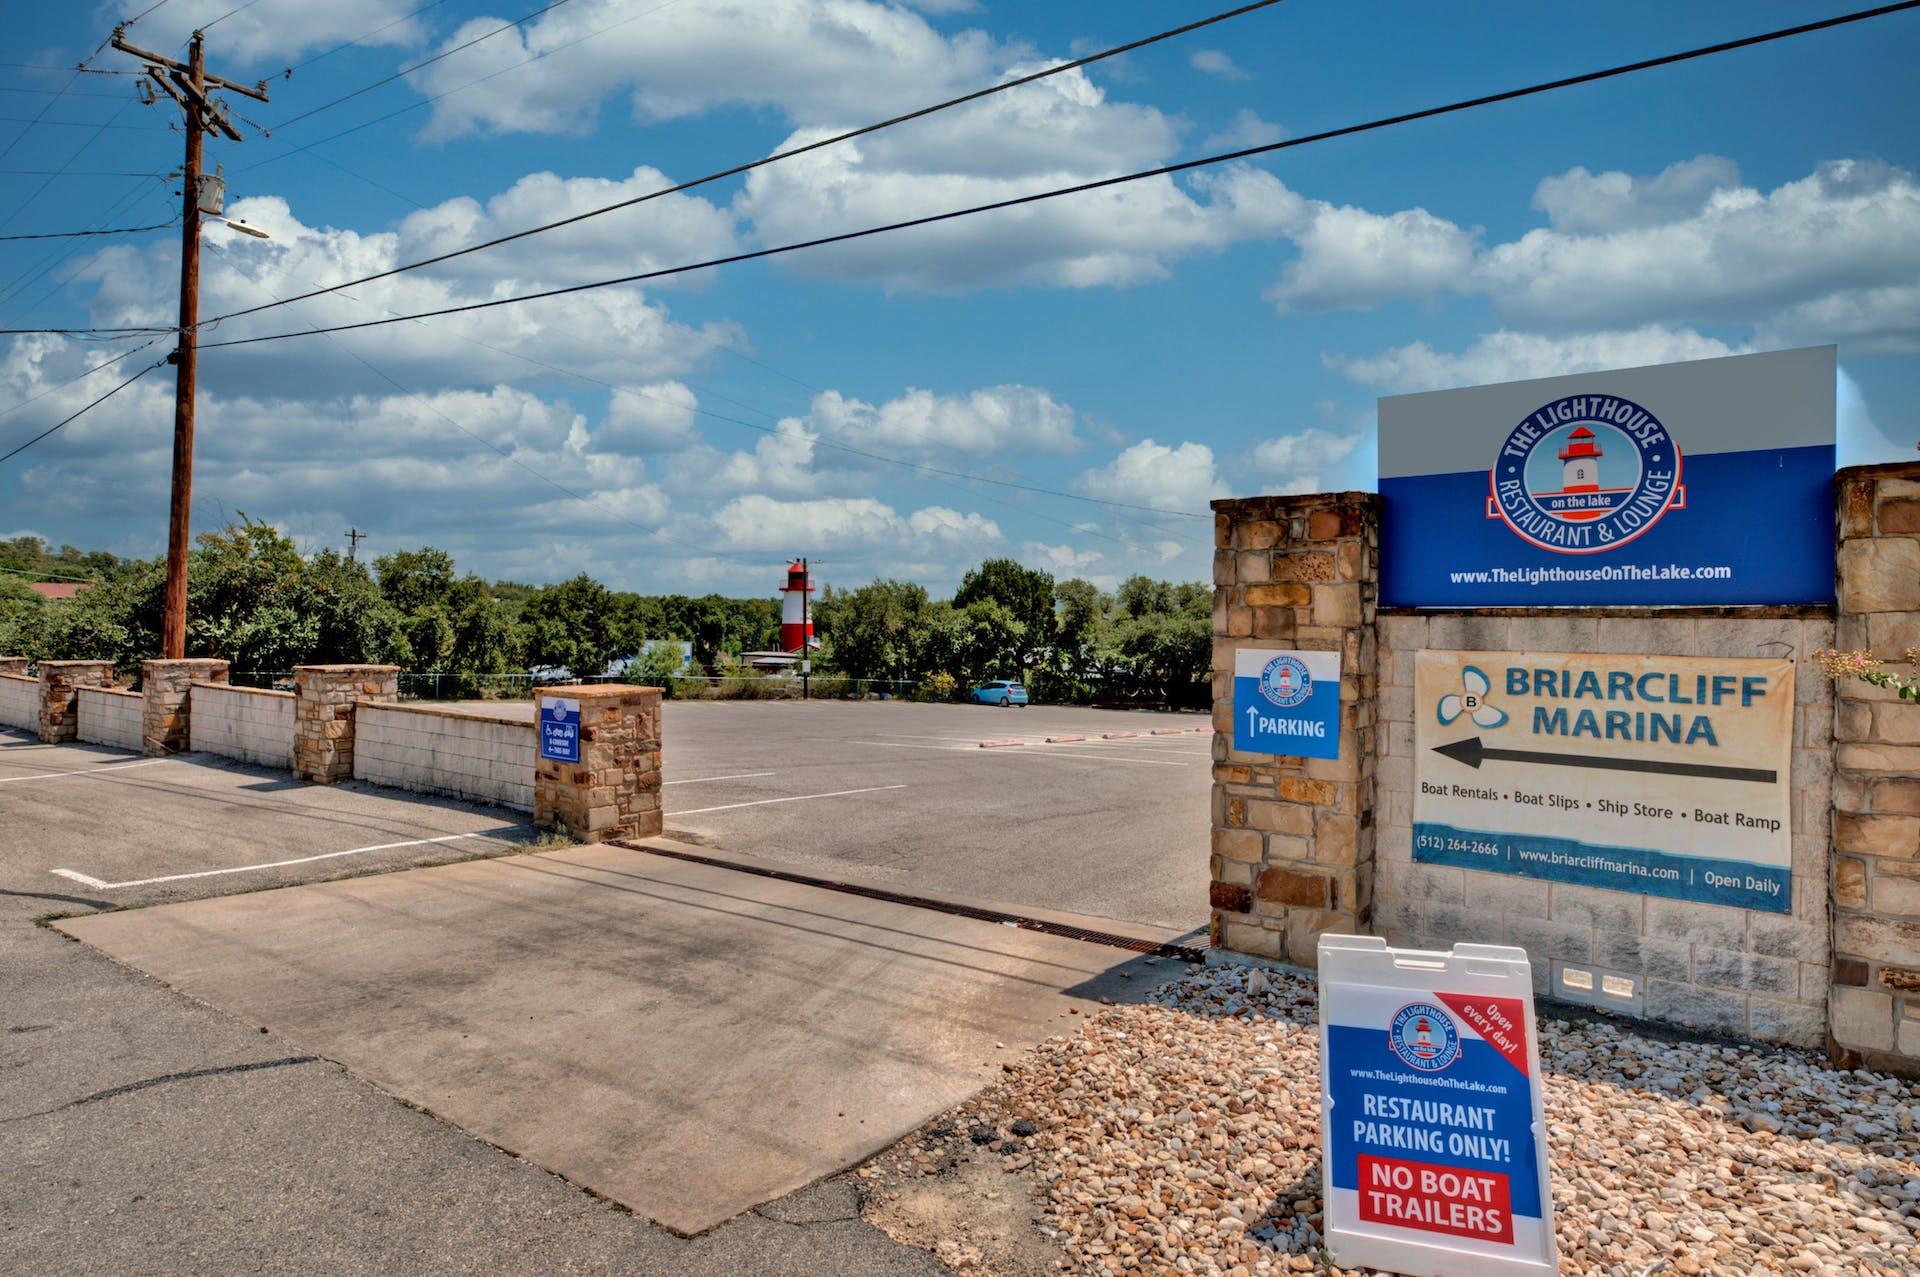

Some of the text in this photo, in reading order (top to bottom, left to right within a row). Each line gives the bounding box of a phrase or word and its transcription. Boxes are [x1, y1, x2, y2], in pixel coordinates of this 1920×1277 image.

[1504, 397, 1665, 457] THE LIGHTHOUSE
[1499, 469, 1671, 546] RESTAURANT & LOUNGE
[1551, 494, 1611, 508] on the lake
[1450, 564, 1731, 586] www.TheLighthouseOnTheLake.com
[1466, 696, 1476, 707] B
[1506, 667, 1767, 707] BRIARCLIFF
[1259, 717, 1325, 738] PARKING
[1532, 706, 1719, 747] MARINA
[1421, 782, 1781, 833] Boat Rentals Boat Slips Ship Store Boat Ramp
[1416, 835, 1781, 896] (512) 264-2666 www.briarcliffmarina.com Open Daily
[1395, 1006, 1453, 1032] THE LIGHTHOUSE
[1463, 1005, 1518, 1054] every day!
[1486, 1004, 1513, 1031] Open
[1393, 1035, 1430, 1068] RESTAURANT
[1431, 1060, 1438, 1068] &
[1350, 1068, 1507, 1094] www.TheLighthouseOnTheLake.com
[1363, 1093, 1496, 1131] RESTAURANT
[1353, 1120, 1511, 1163] PARKING ONLY!
[1371, 1162, 1496, 1202] NO BOAT
[1368, 1191, 1503, 1234] TRAILERS
